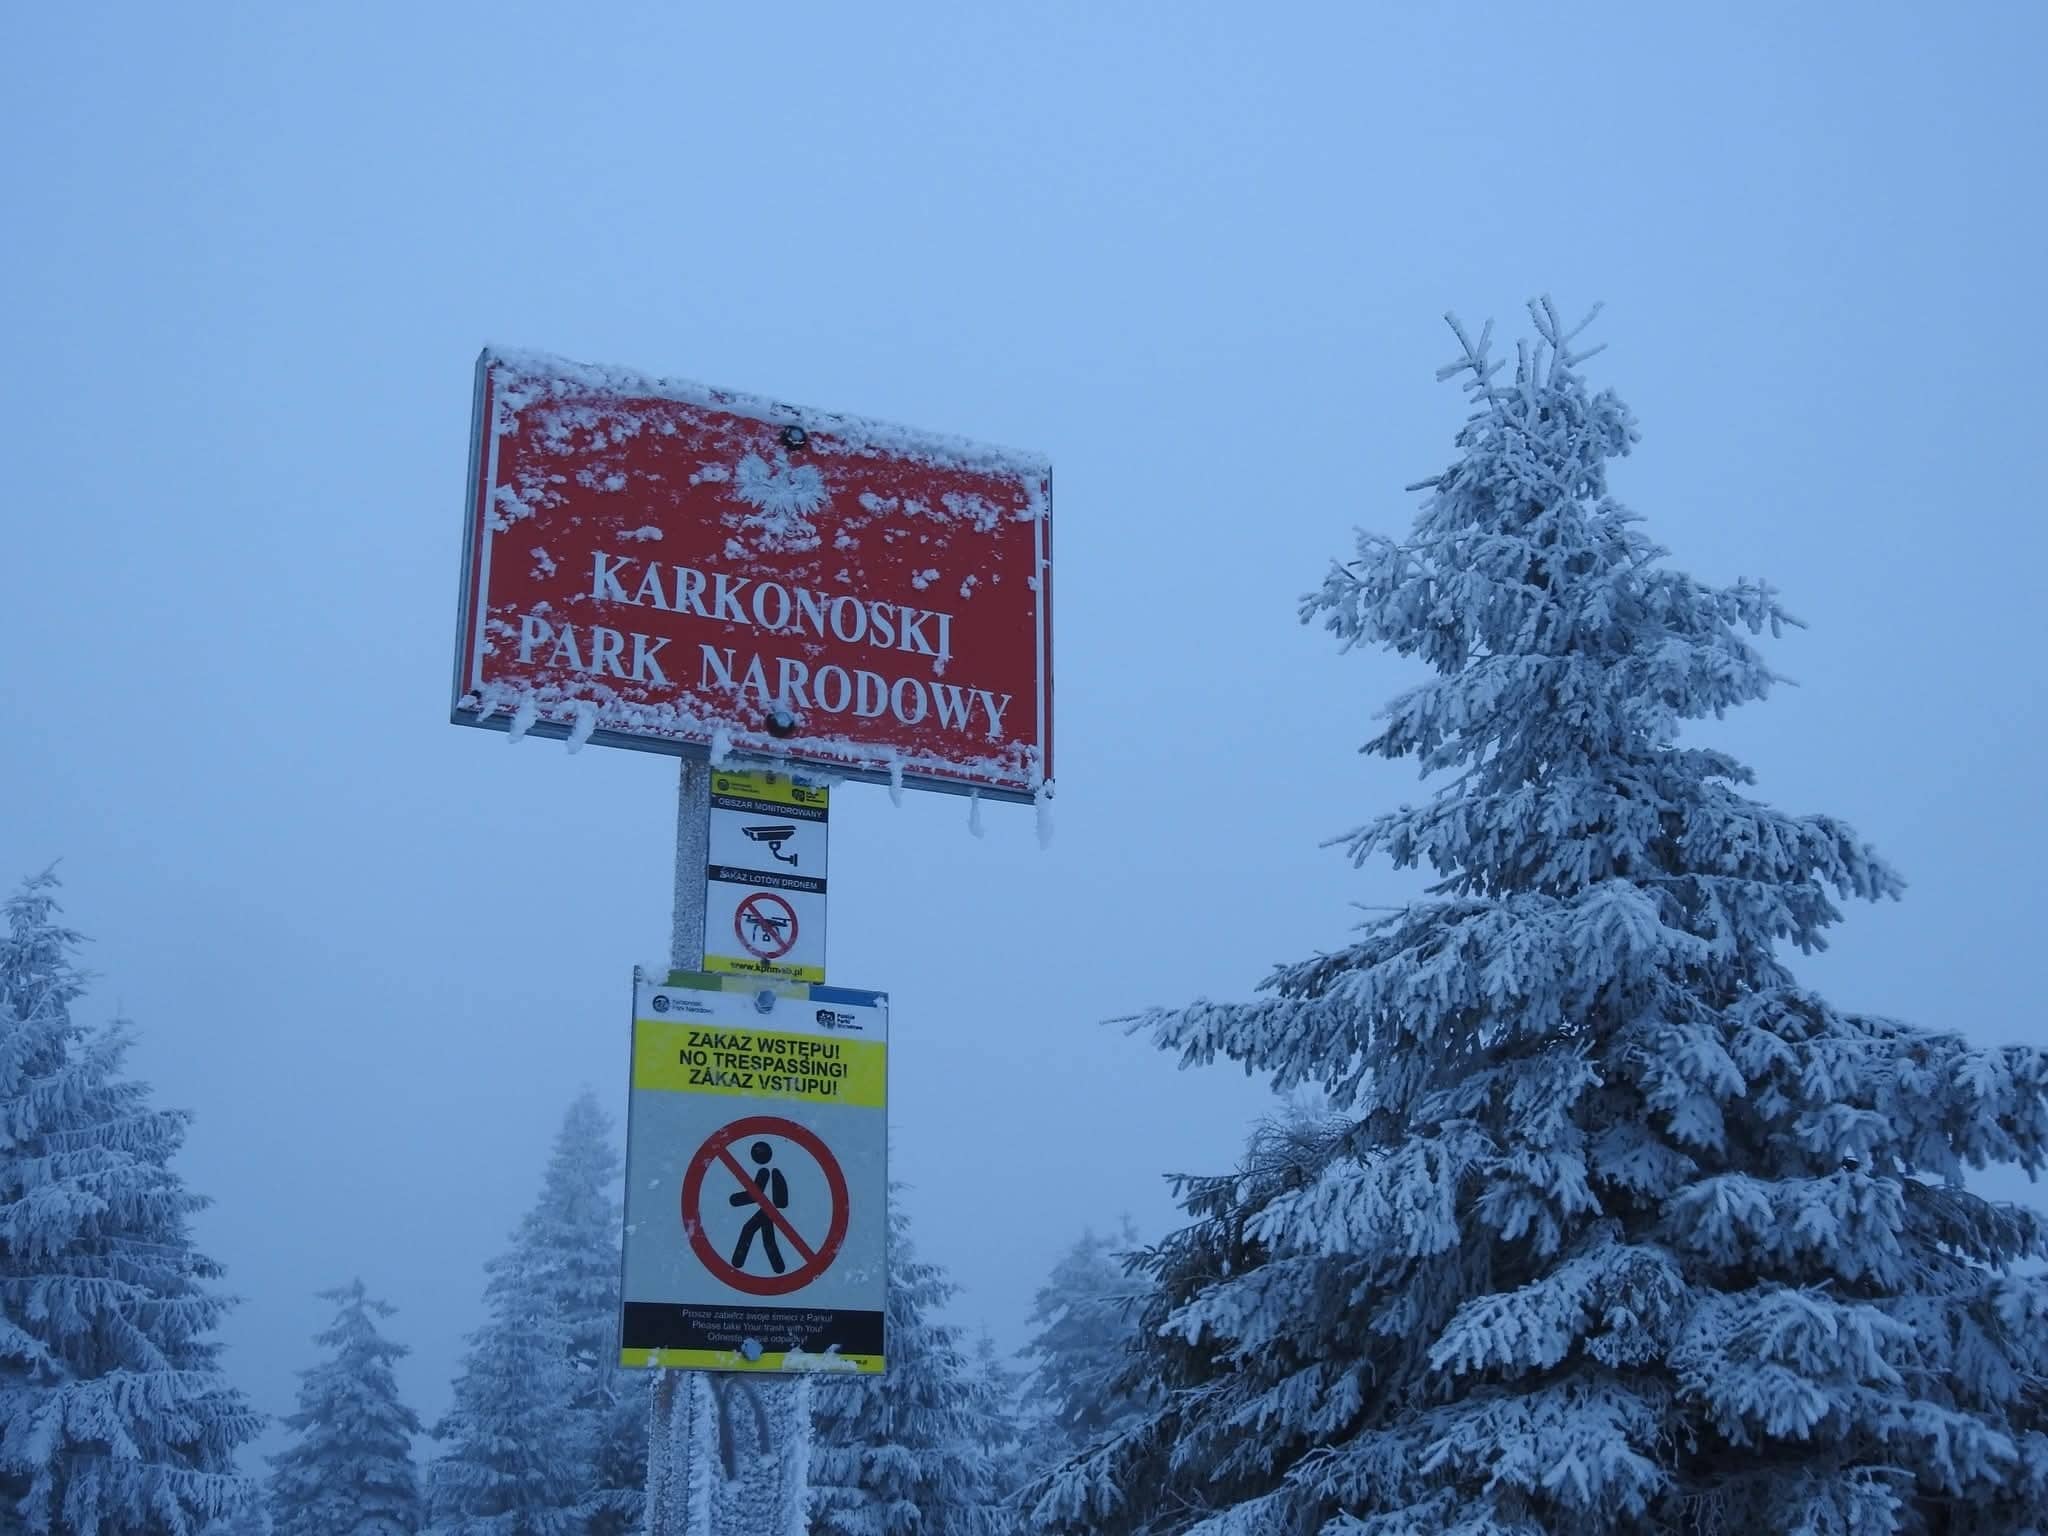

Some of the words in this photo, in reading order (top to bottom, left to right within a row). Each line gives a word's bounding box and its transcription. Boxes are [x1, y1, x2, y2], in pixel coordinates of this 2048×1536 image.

[589, 550, 954, 661] KARKONOSKI
[517, 613, 673, 688] PARK
[698, 643, 1013, 739] NARODOWY
[718, 797, 753, 809] OBSZAR
[755, 802, 824, 818] MONITOROWANY
[781, 878, 818, 890] DRONEM
[687, 1031, 753, 1052] ZAKAZ
[757, 1037, 841, 1060] WSTĘPU!
[679, 1050, 707, 1067] NO
[713, 1052, 848, 1079] TRESPASSING!
[688, 1067, 754, 1089] ZÁKAZ
[758, 1075, 838, 1096] VSTUPU!
[692, 1320, 721, 1331] Please
